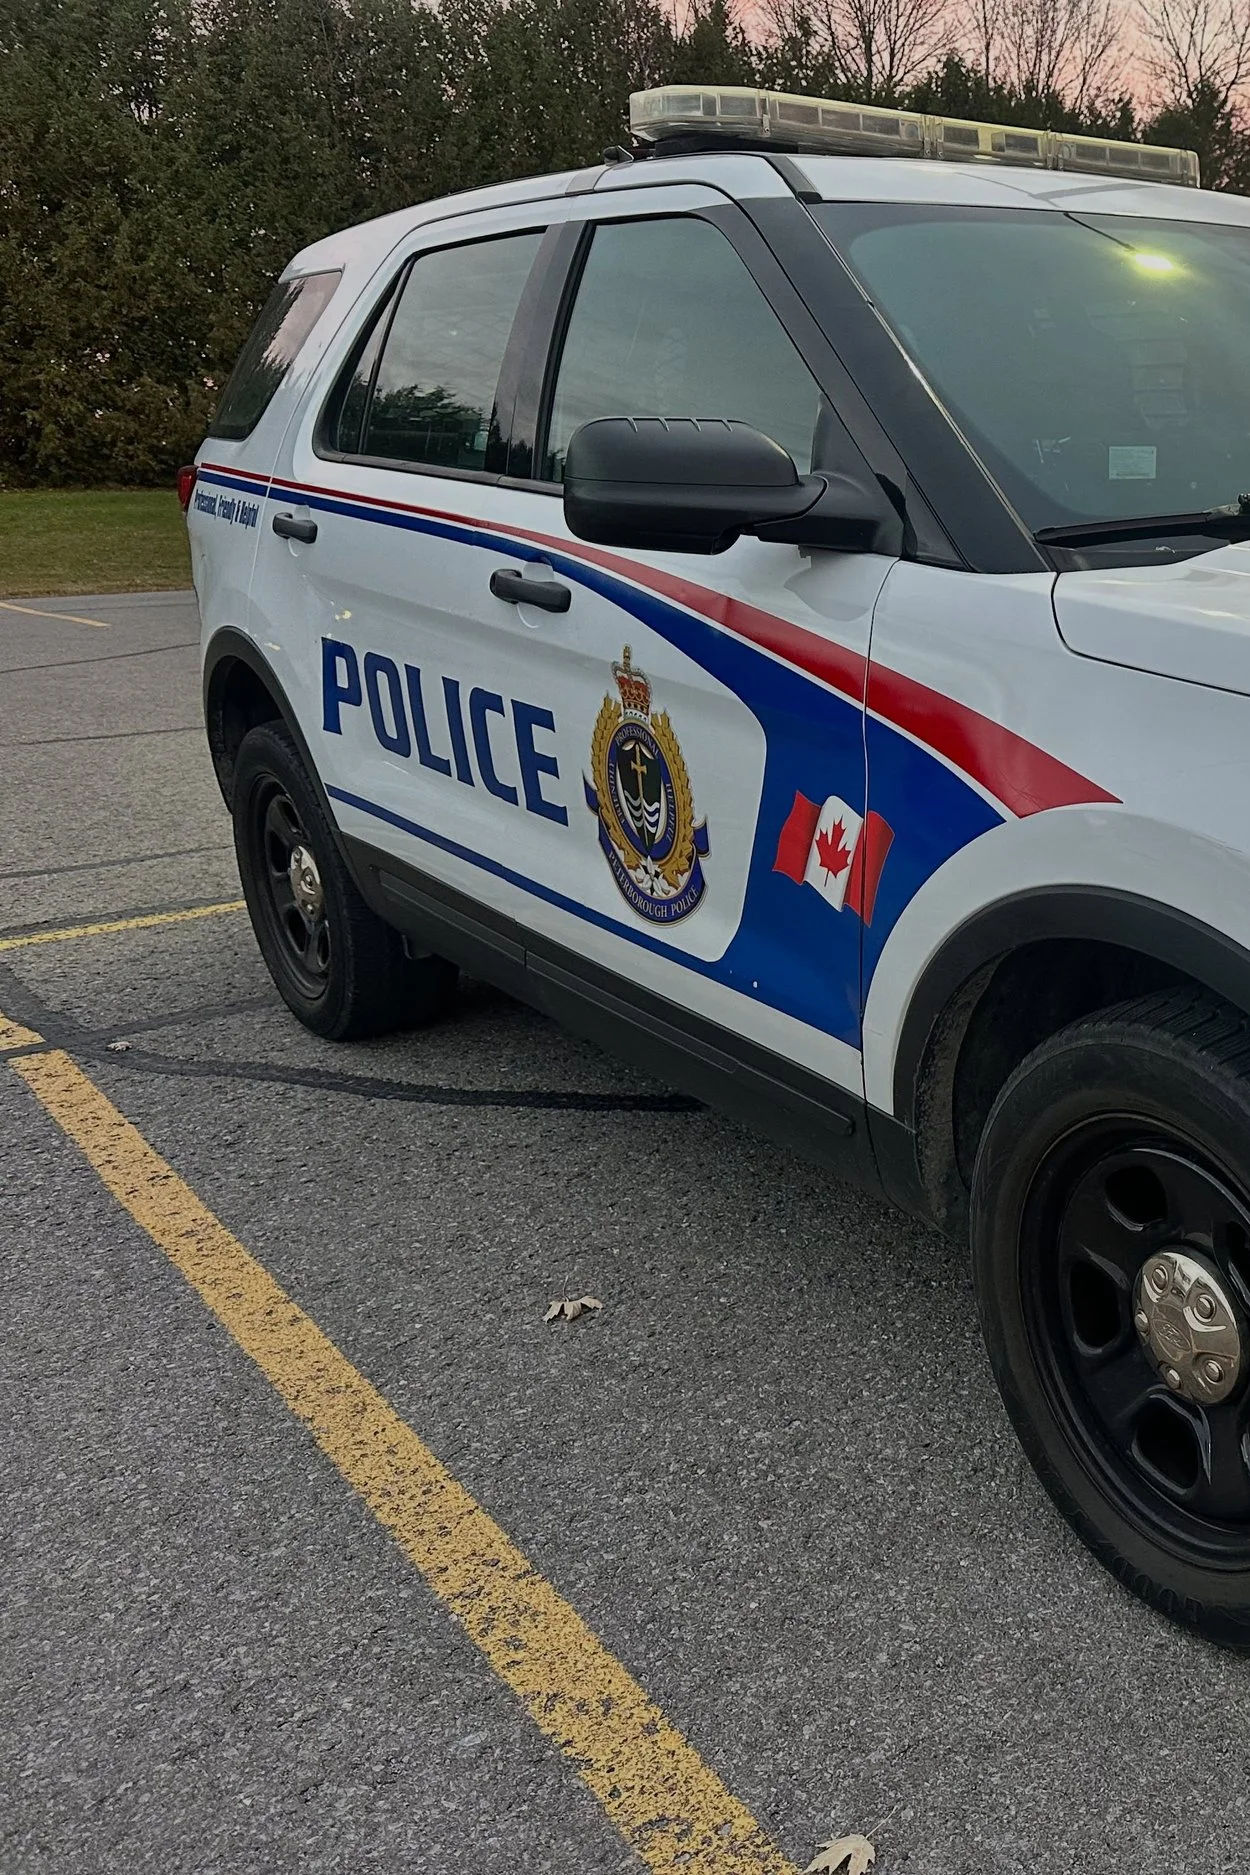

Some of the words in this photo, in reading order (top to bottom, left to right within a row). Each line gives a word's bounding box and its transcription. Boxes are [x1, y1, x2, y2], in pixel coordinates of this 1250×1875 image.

[321, 636, 569, 827] POLICE
[615, 726, 660, 757] PROFESSIONAL
[609, 851, 668, 918] PETERBOROUGH
[671, 884, 699, 917] POLICE
